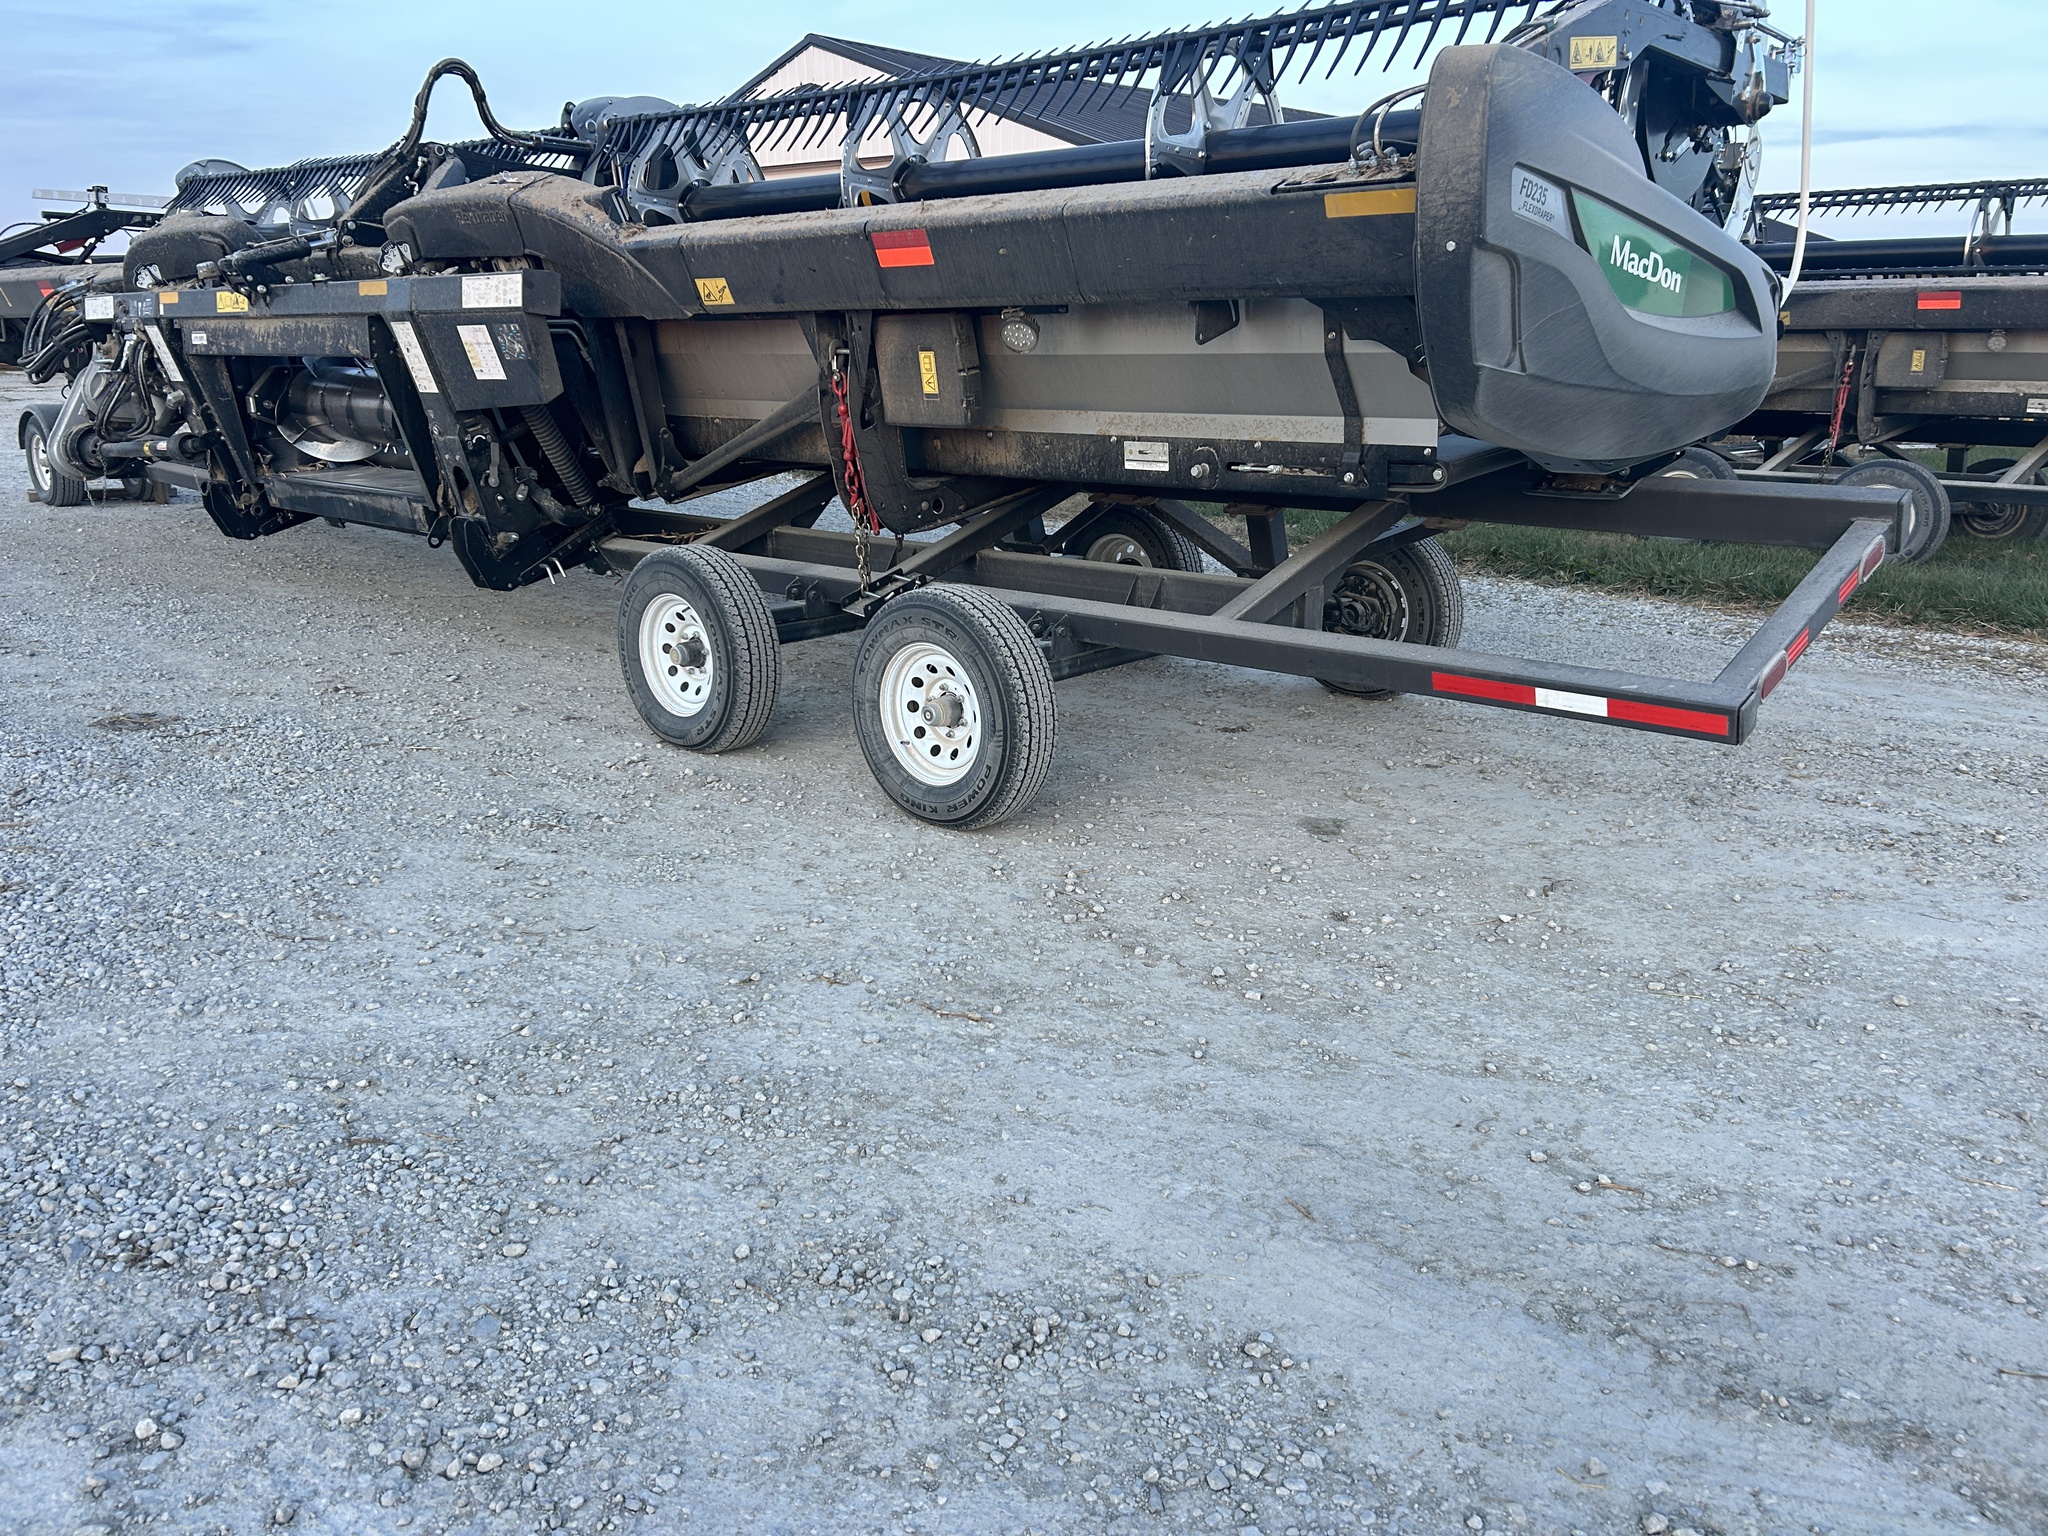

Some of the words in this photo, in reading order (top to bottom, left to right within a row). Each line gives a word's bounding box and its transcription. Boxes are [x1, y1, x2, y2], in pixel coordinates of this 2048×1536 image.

[1519, 176, 1549, 206] FD235
[1610, 234, 1683, 293] MacDon
[622, 583, 639, 618] KING
[1416, 597, 1426, 636] STR
[620, 626, 636, 695] POWER
[704, 608, 724, 703] TOWMAX
[858, 615, 914, 676] TOWMAX
[920, 616, 959, 641] STR
[697, 710, 717, 736] STR
[898, 789, 939, 814] KING
[946, 764, 992, 813] POWER
